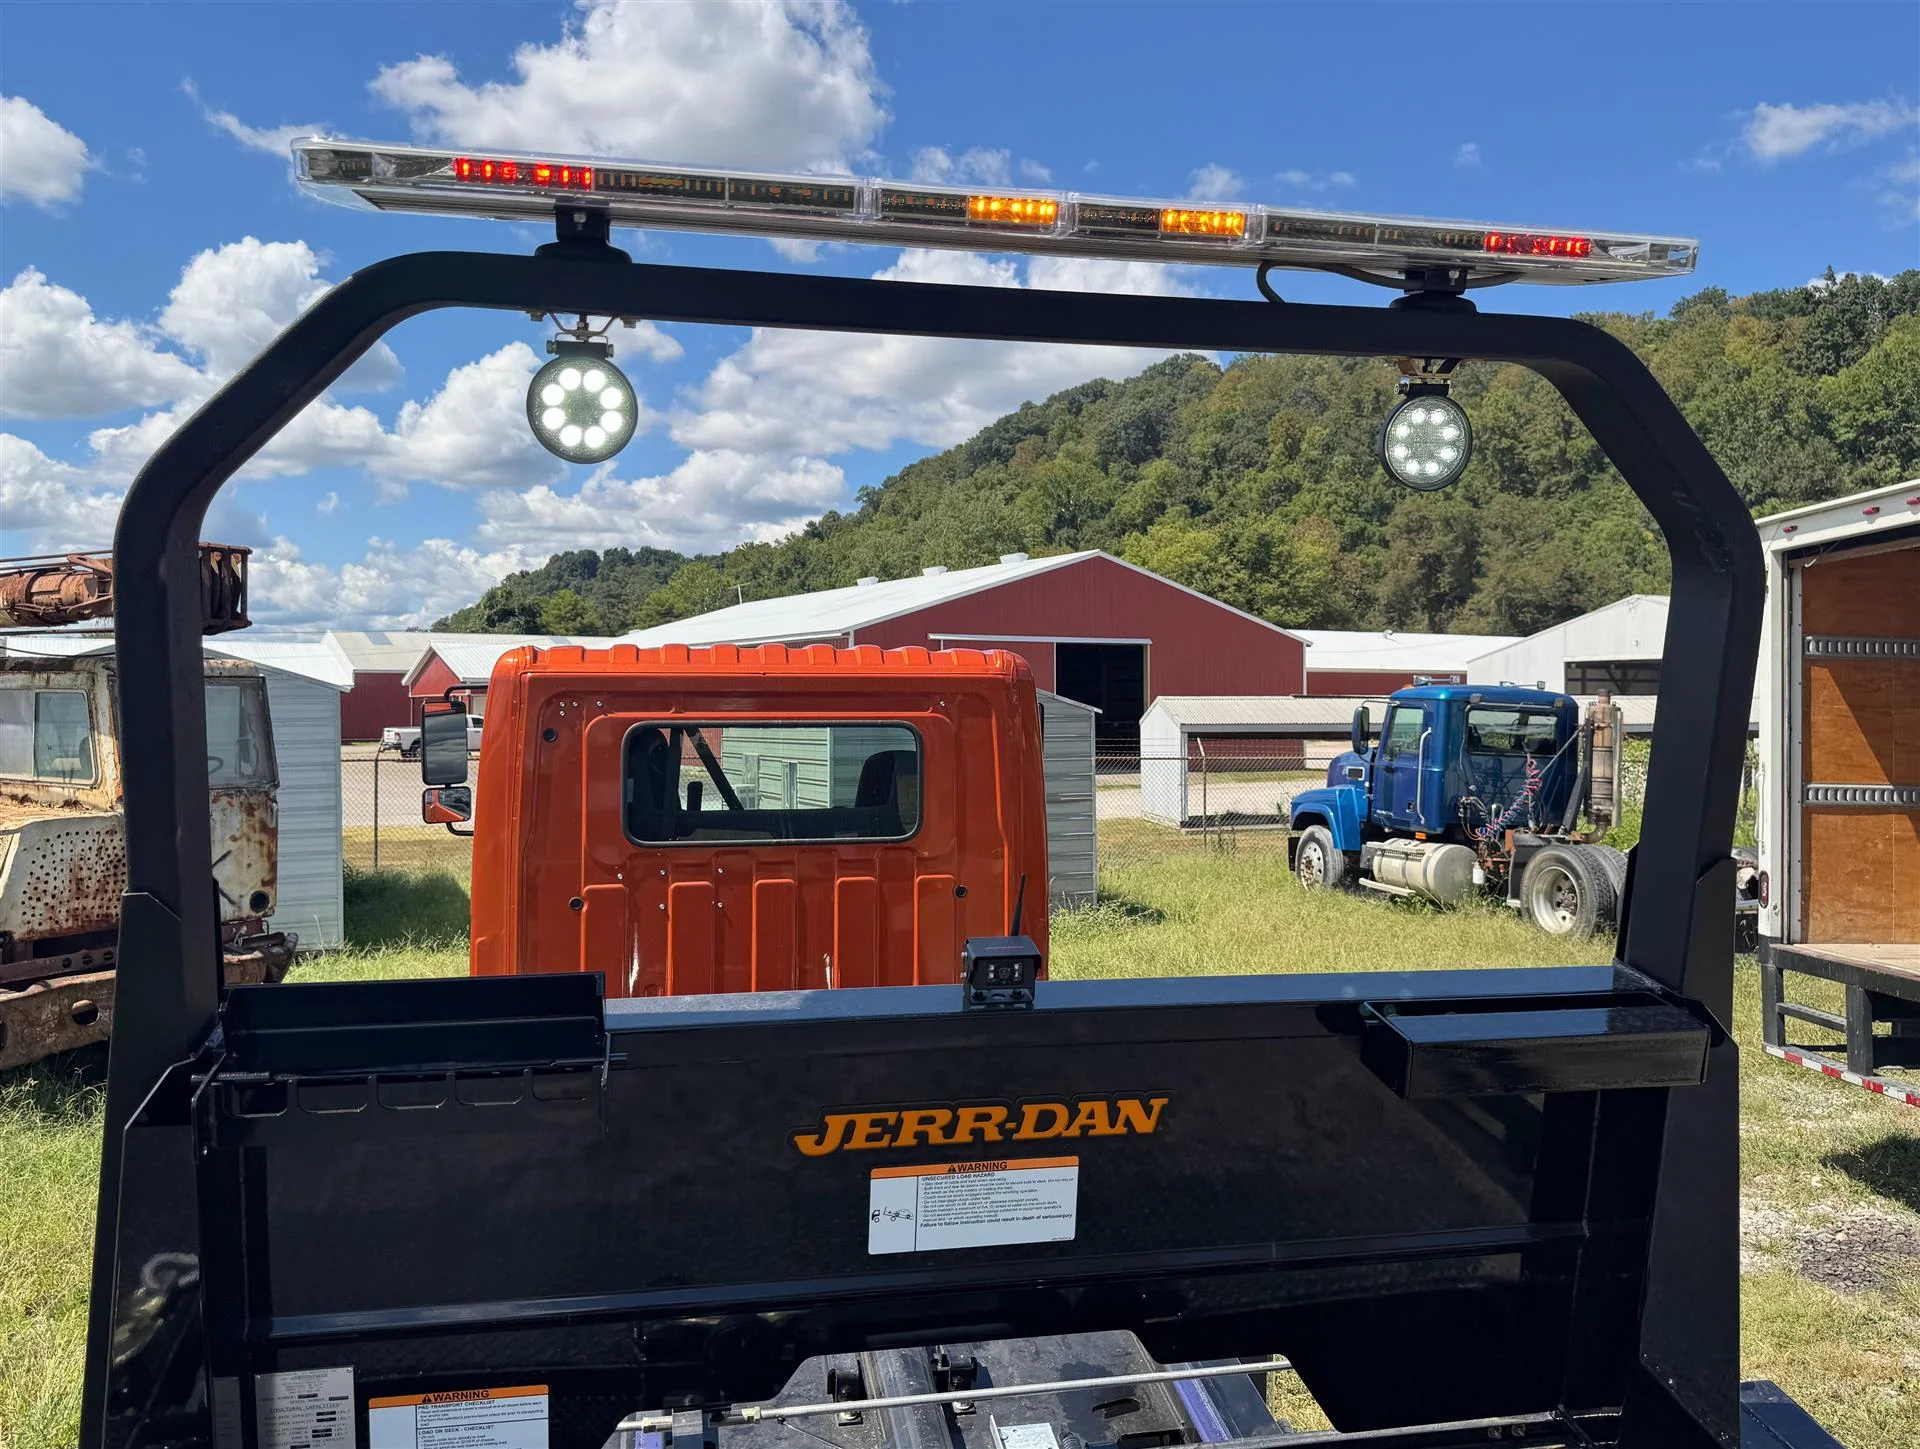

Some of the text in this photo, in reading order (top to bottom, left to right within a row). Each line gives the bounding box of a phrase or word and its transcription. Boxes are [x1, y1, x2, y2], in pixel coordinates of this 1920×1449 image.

[793, 1097, 1169, 1157] JERR-DAN
[957, 1162, 1008, 1172] WARNING
[432, 1390, 489, 1402] WARNING
